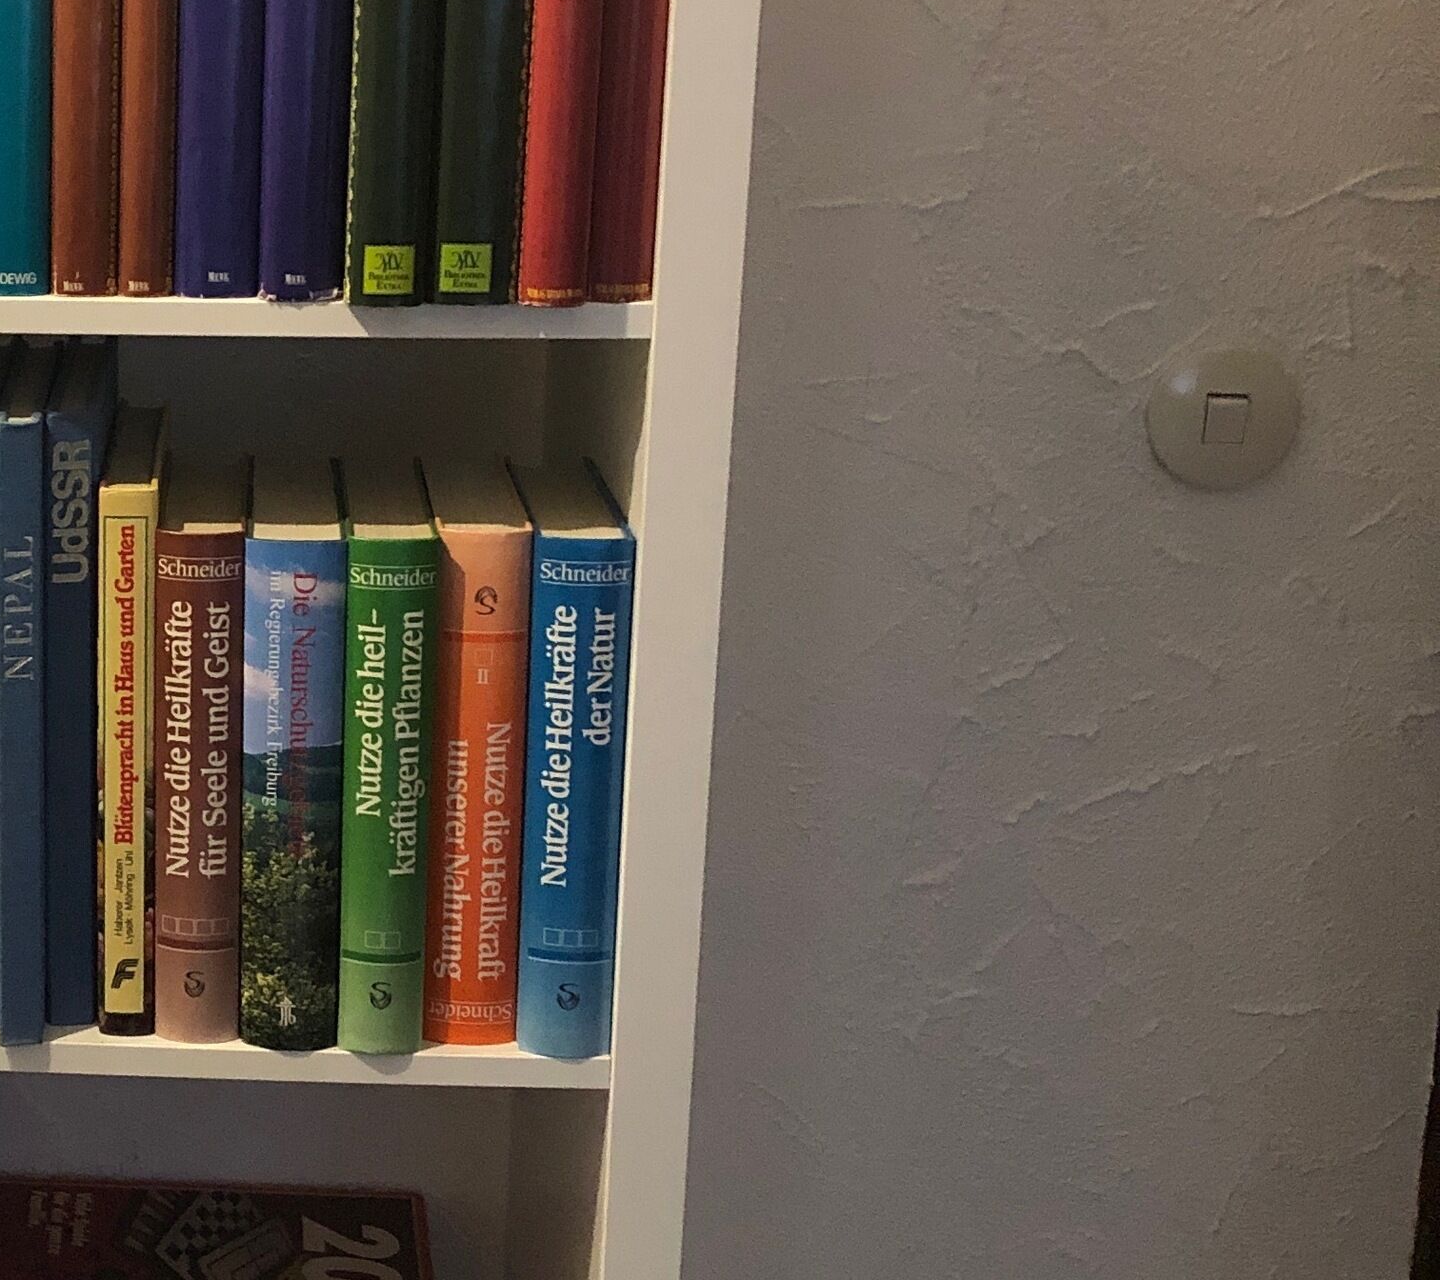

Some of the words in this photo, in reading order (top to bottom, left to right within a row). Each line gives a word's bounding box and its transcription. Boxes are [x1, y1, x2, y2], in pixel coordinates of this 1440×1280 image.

[50, 438, 91, 584] UdSSR
[114, 525, 137, 593] Garten
[158, 558, 242, 578] Schneider
[268, 570, 285, 592] im
[292, 572, 318, 617] Die
[349, 567, 439, 587] Schneider
[540, 563, 632, 583] Schneider
[2, 535, 34, 681] NEPAL
[114, 597, 136, 635] und
[202, 600, 231, 679] Geist
[114, 641, 137, 694] Haus
[164, 600, 192, 745] Heilkräfte
[264, 597, 285, 735] Regierungsbezirk
[356, 609, 387, 681] heil-
[391, 609, 424, 741] Pflanzen
[544, 605, 578, 752] Heilkräfte
[586, 607, 616, 694] Natur
[114, 697, 134, 717] in
[201, 684, 229, 743] und
[355, 685, 384, 730] die
[581, 697, 612, 746] der
[114, 721, 139, 845] Blütenpracht
[164, 746, 191, 791] die
[199, 750, 228, 828] Seele
[261, 741, 284, 807] Freiburg
[355, 733, 384, 818] Nutze
[444, 738, 470, 852] unserer
[483, 720, 511, 806] Nutze
[540, 753, 572, 799] die
[165, 795, 192, 879] Nutze
[388, 745, 428, 878] kräftigen
[481, 809, 510, 854] die
[540, 803, 569, 888] Nutze
[199, 833, 228, 881] für
[433, 852, 472, 982] Nahrung
[476, 855, 508, 982] Heilkraft
[428, 1003, 514, 1022] Schneider
